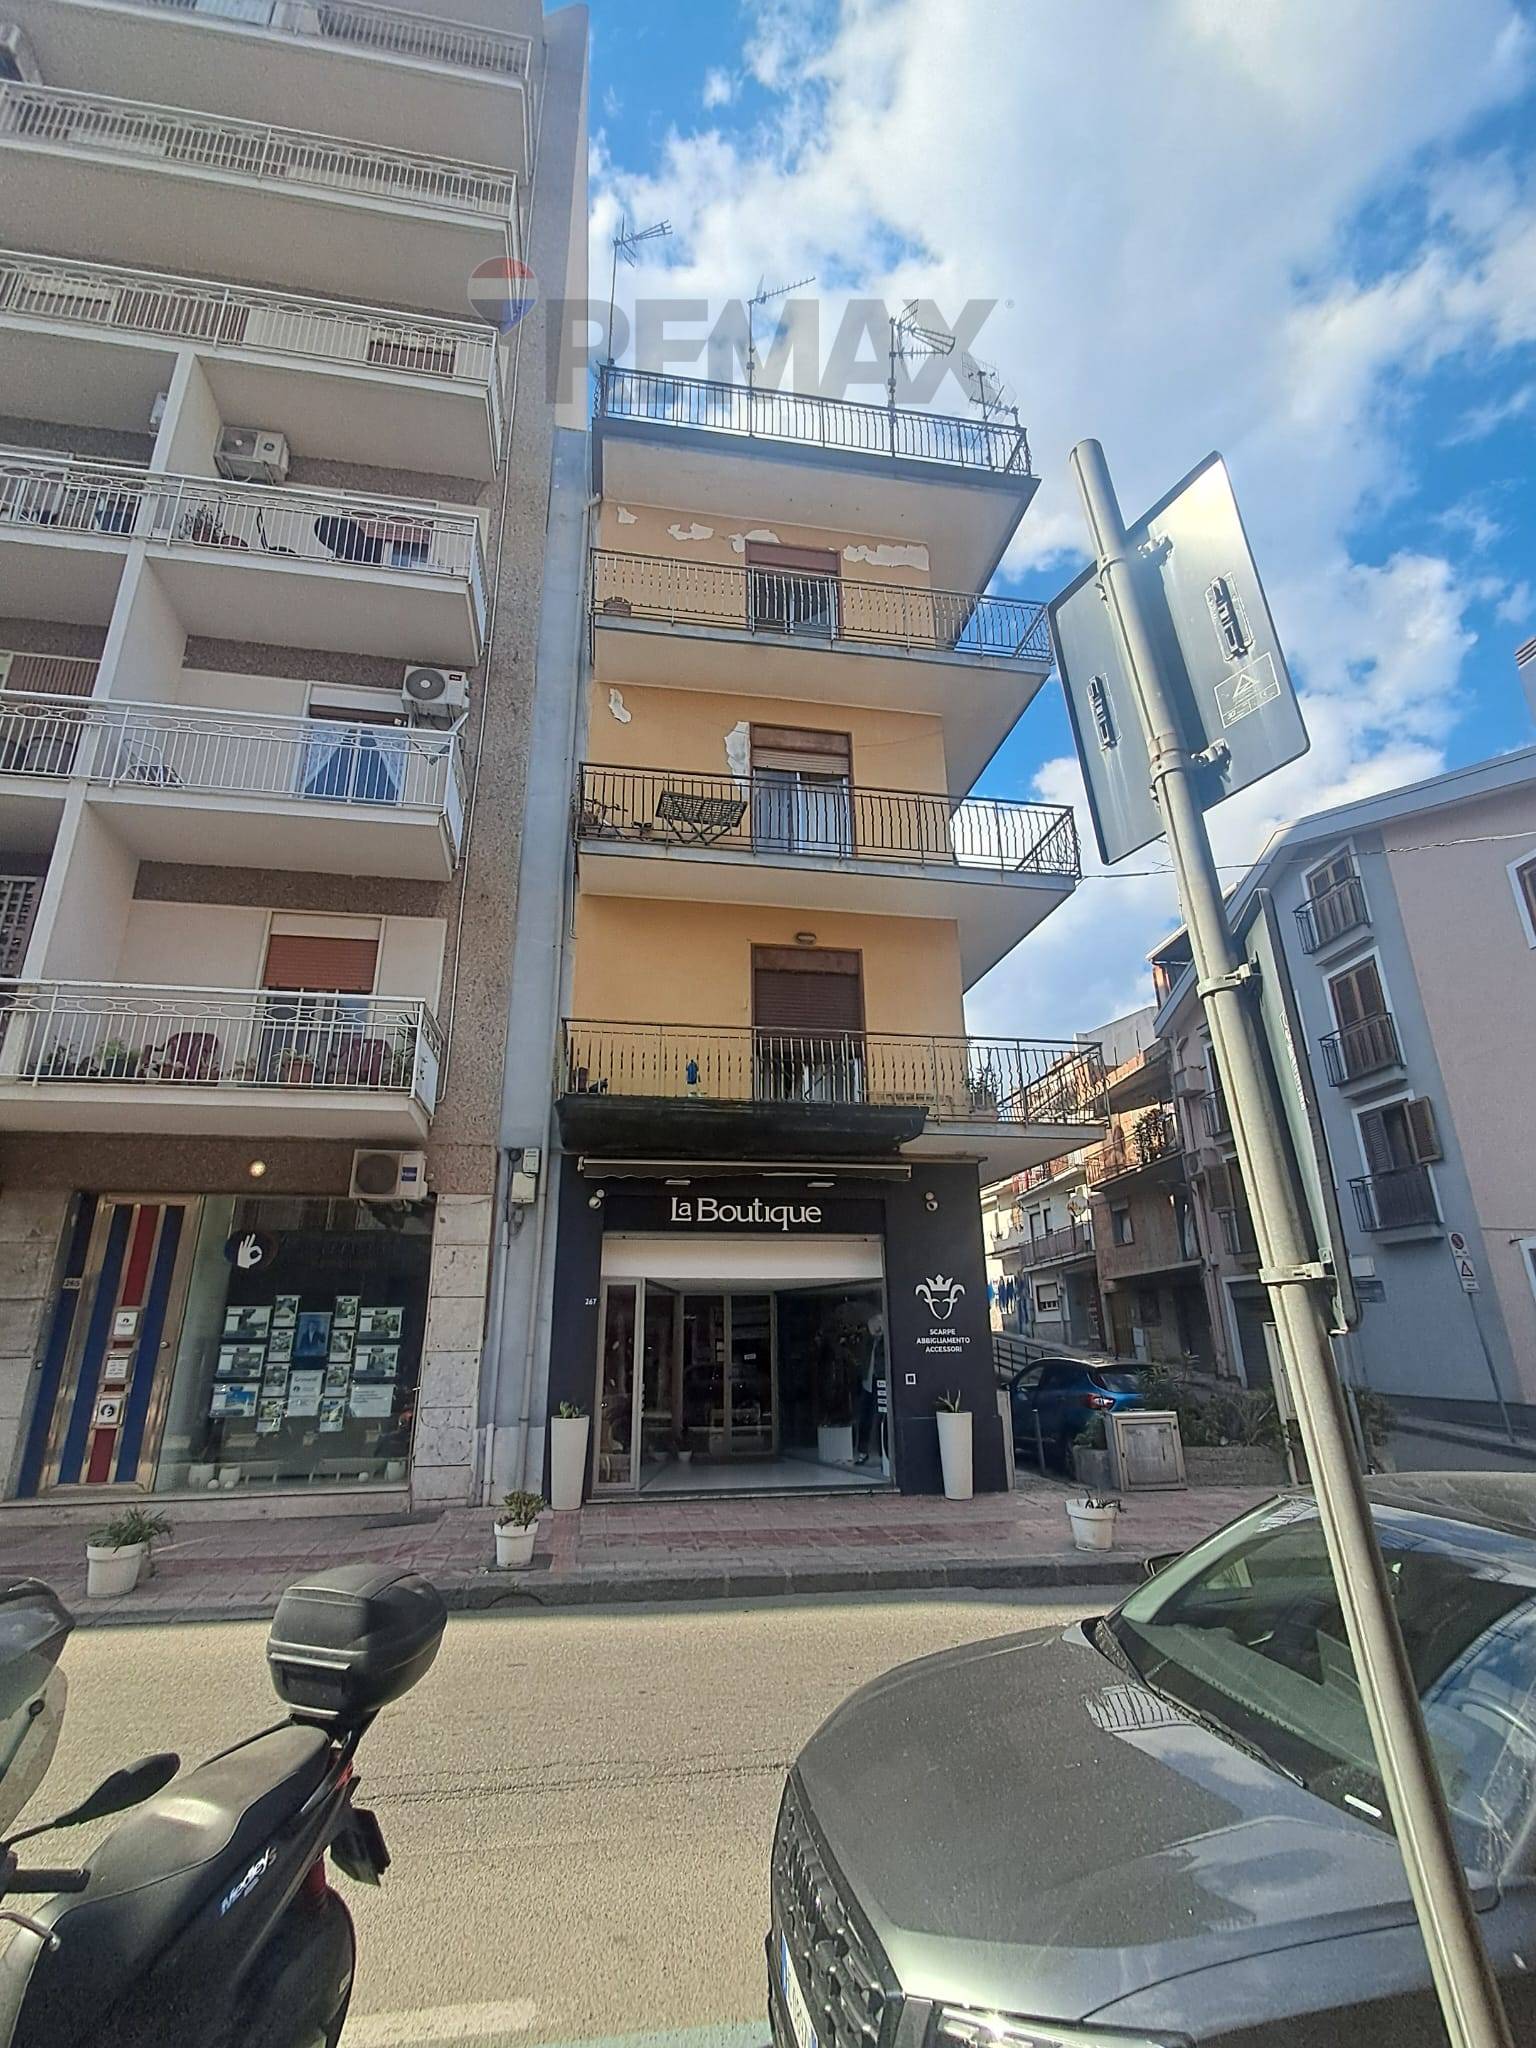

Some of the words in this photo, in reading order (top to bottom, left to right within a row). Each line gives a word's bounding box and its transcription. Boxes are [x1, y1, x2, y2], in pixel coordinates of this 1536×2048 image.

[671, 1197, 692, 1222] La
[697, 1197, 822, 1231] Boutique
[929, 1328, 956, 1336] SCARPE
[916, 1337, 971, 1345] ABBIGLIAMENTO
[925, 1345, 963, 1353] ACCESSORI
